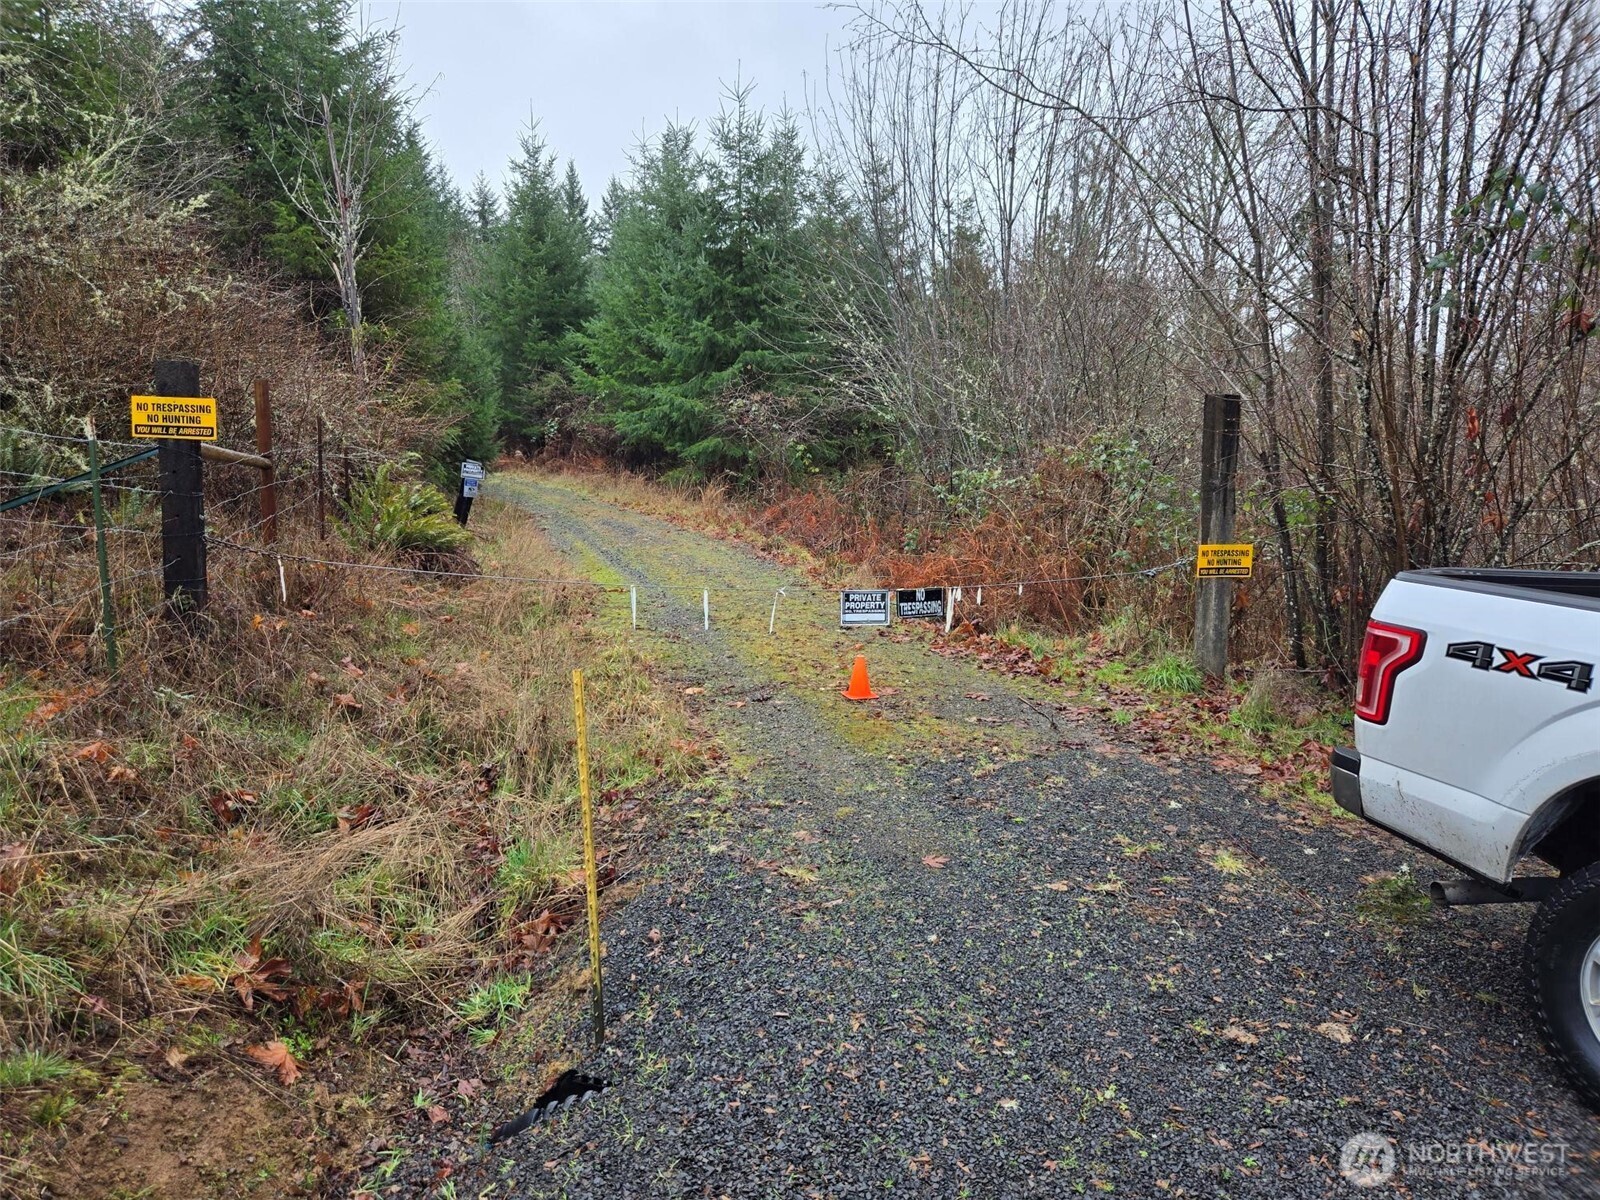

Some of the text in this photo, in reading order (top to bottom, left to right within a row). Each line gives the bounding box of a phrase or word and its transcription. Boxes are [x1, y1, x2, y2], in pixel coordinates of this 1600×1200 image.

[136, 403, 211, 414] NO TRESPASSING
[147, 414, 201, 424] NO HUNTING
[178, 428, 212, 436] ARRESTED
[916, 589, 925, 600] NO
[900, 601, 942, 615] TRESPASSING
